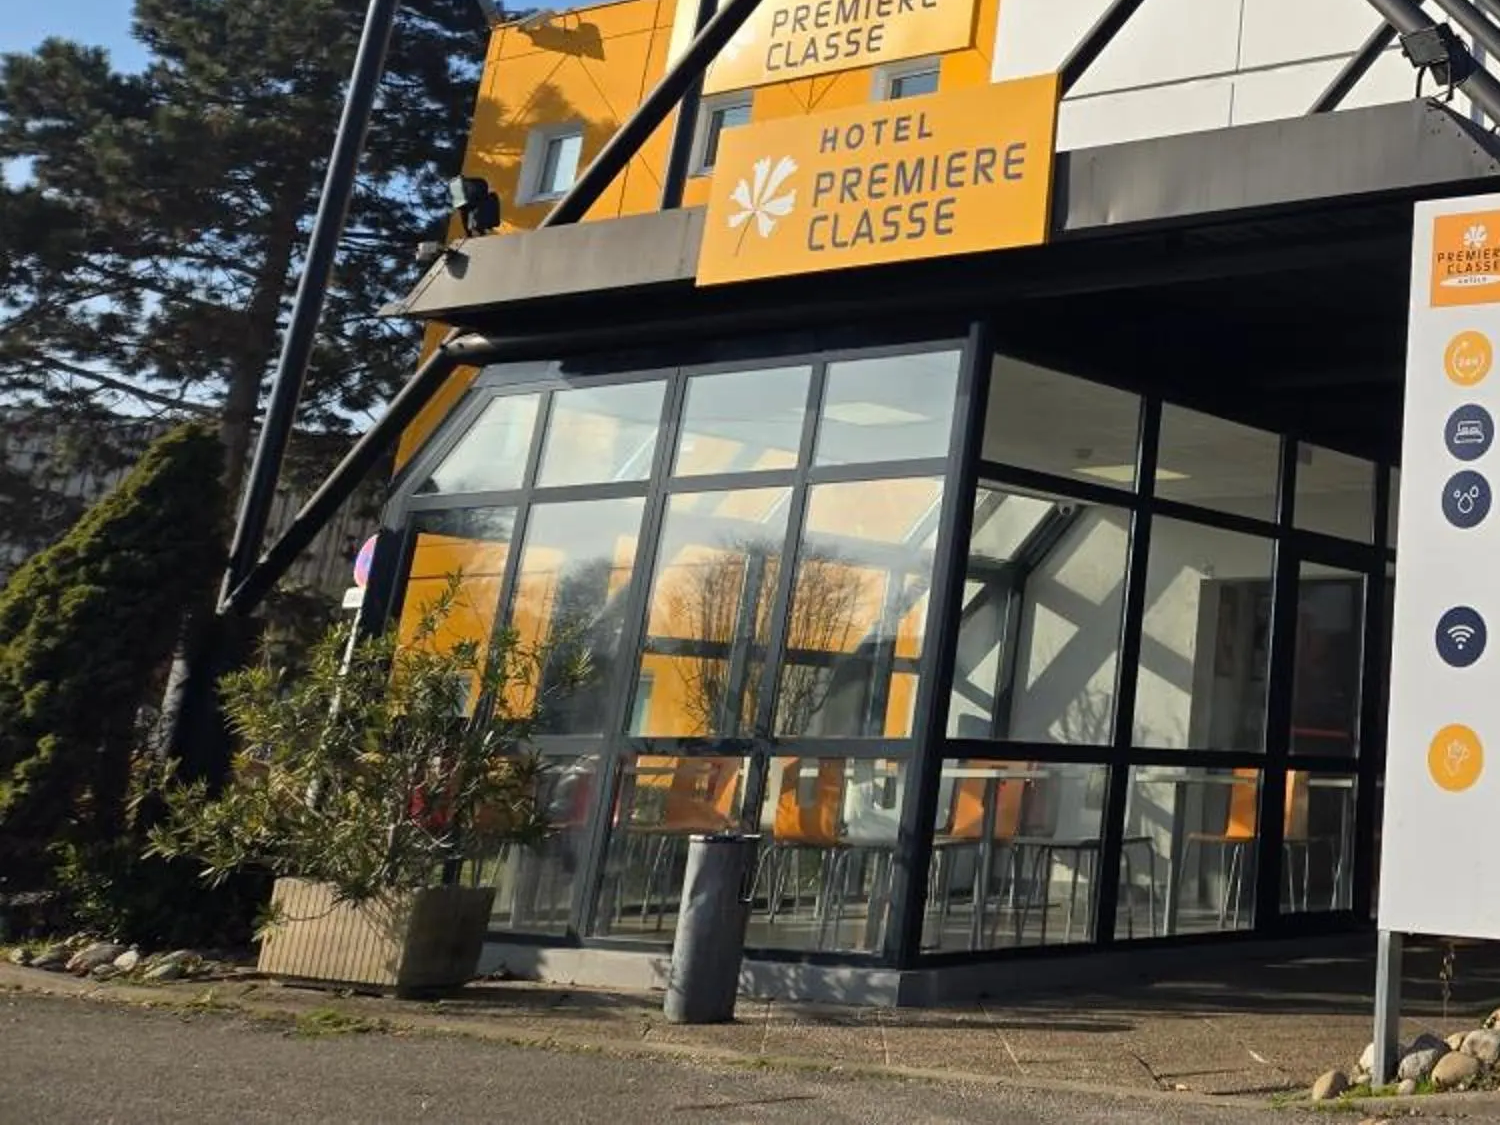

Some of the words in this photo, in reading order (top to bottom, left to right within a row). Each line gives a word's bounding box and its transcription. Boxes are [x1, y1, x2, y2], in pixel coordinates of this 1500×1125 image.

[766, 24, 886, 72] CLASSE
[819, 112, 934, 154] HOTEL
[812, 142, 1028, 208] PREMIERE
[807, 197, 957, 251] CLASSE
[1447, 259, 1500, 274] CLASSE
